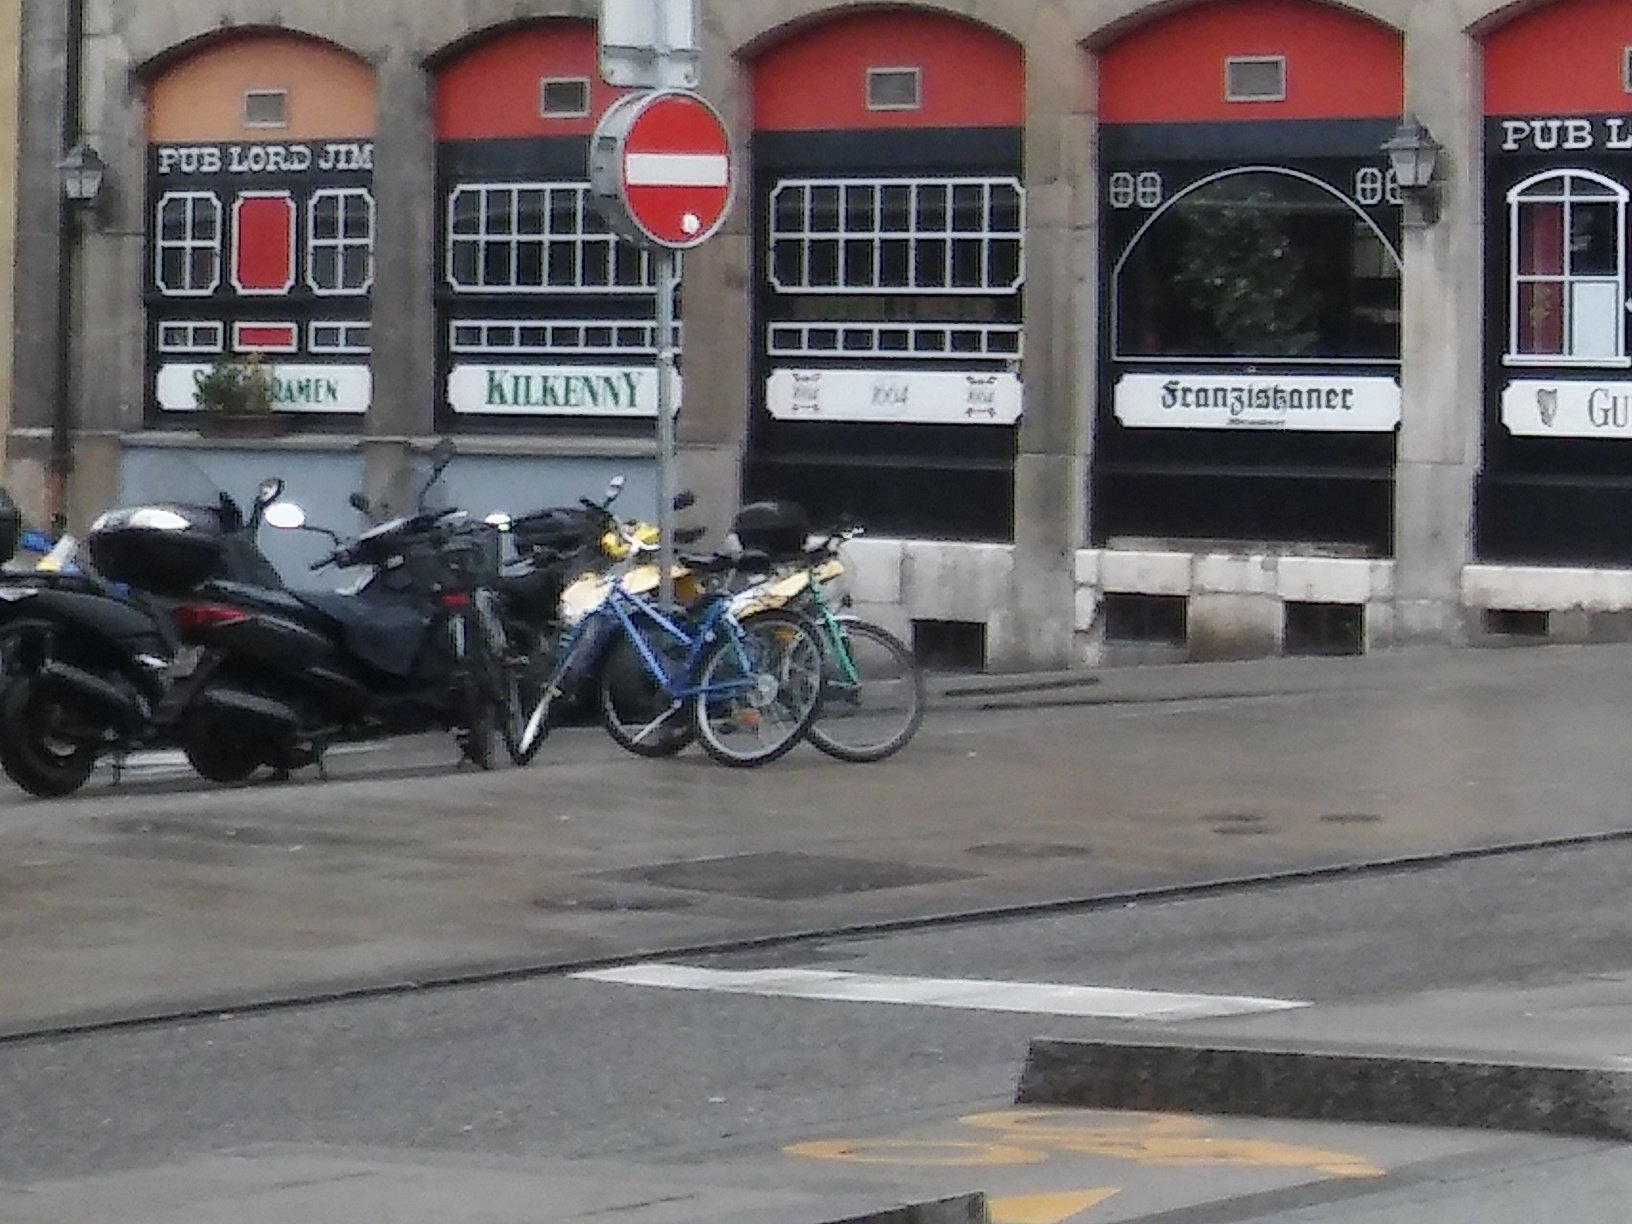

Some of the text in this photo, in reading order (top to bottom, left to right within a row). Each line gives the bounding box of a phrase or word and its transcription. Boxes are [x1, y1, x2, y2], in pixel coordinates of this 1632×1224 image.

[1502, 120, 1594, 150] PUB
[157, 143, 374, 174] PUB LORD JIM
[192, 369, 340, 406] SRAMEN
[485, 369, 642, 408] KILKENNY
[1161, 379, 1354, 416] Franziskaner
